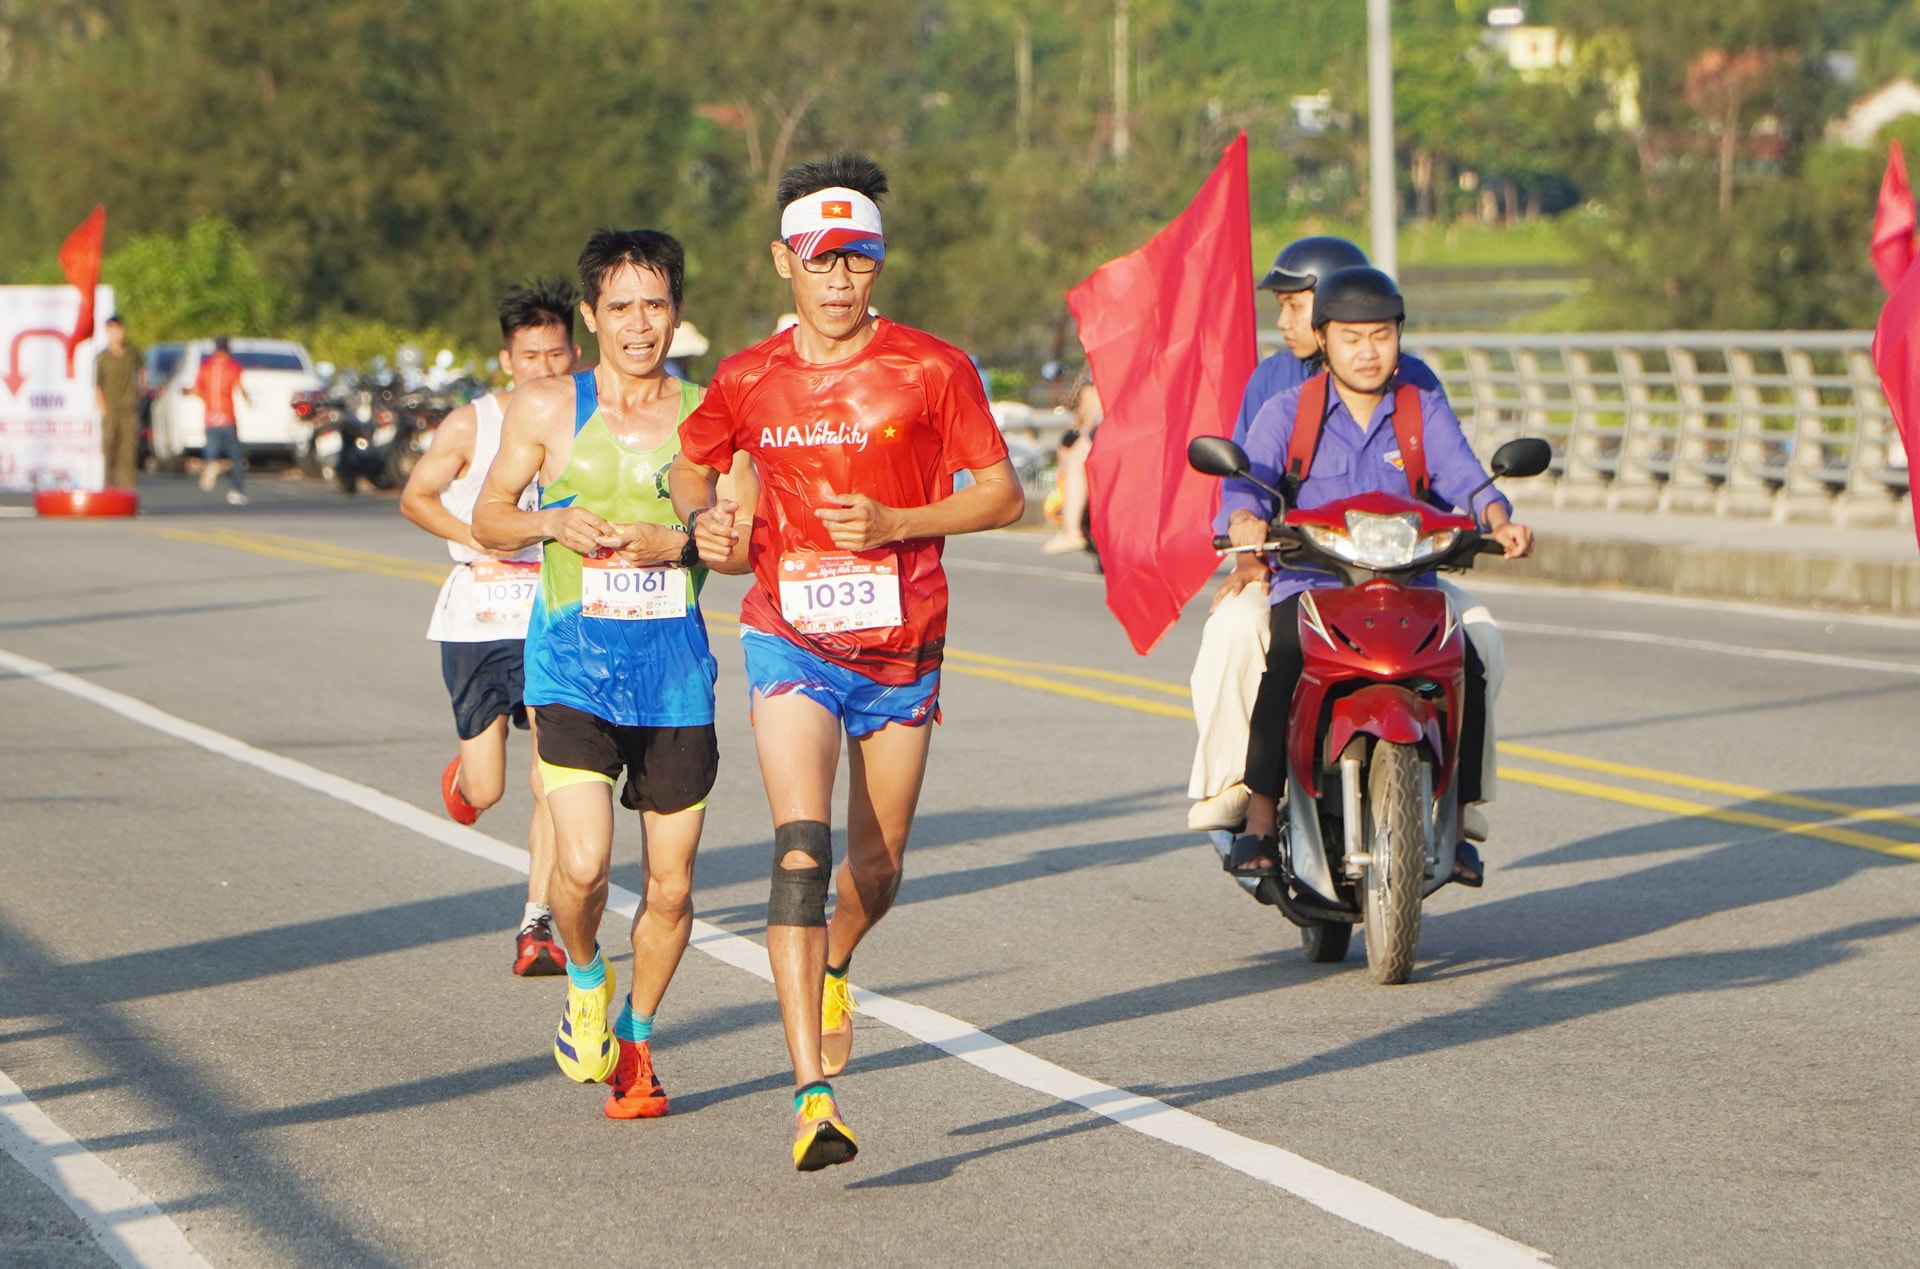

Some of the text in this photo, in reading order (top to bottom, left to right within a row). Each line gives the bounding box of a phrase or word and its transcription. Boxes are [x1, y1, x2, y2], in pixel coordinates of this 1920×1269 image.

[760, 419, 868, 452] AIA Vitality
[486, 583, 533, 600] 1037
[603, 570, 666, 593] 10161
[804, 580, 875, 610] 1033
